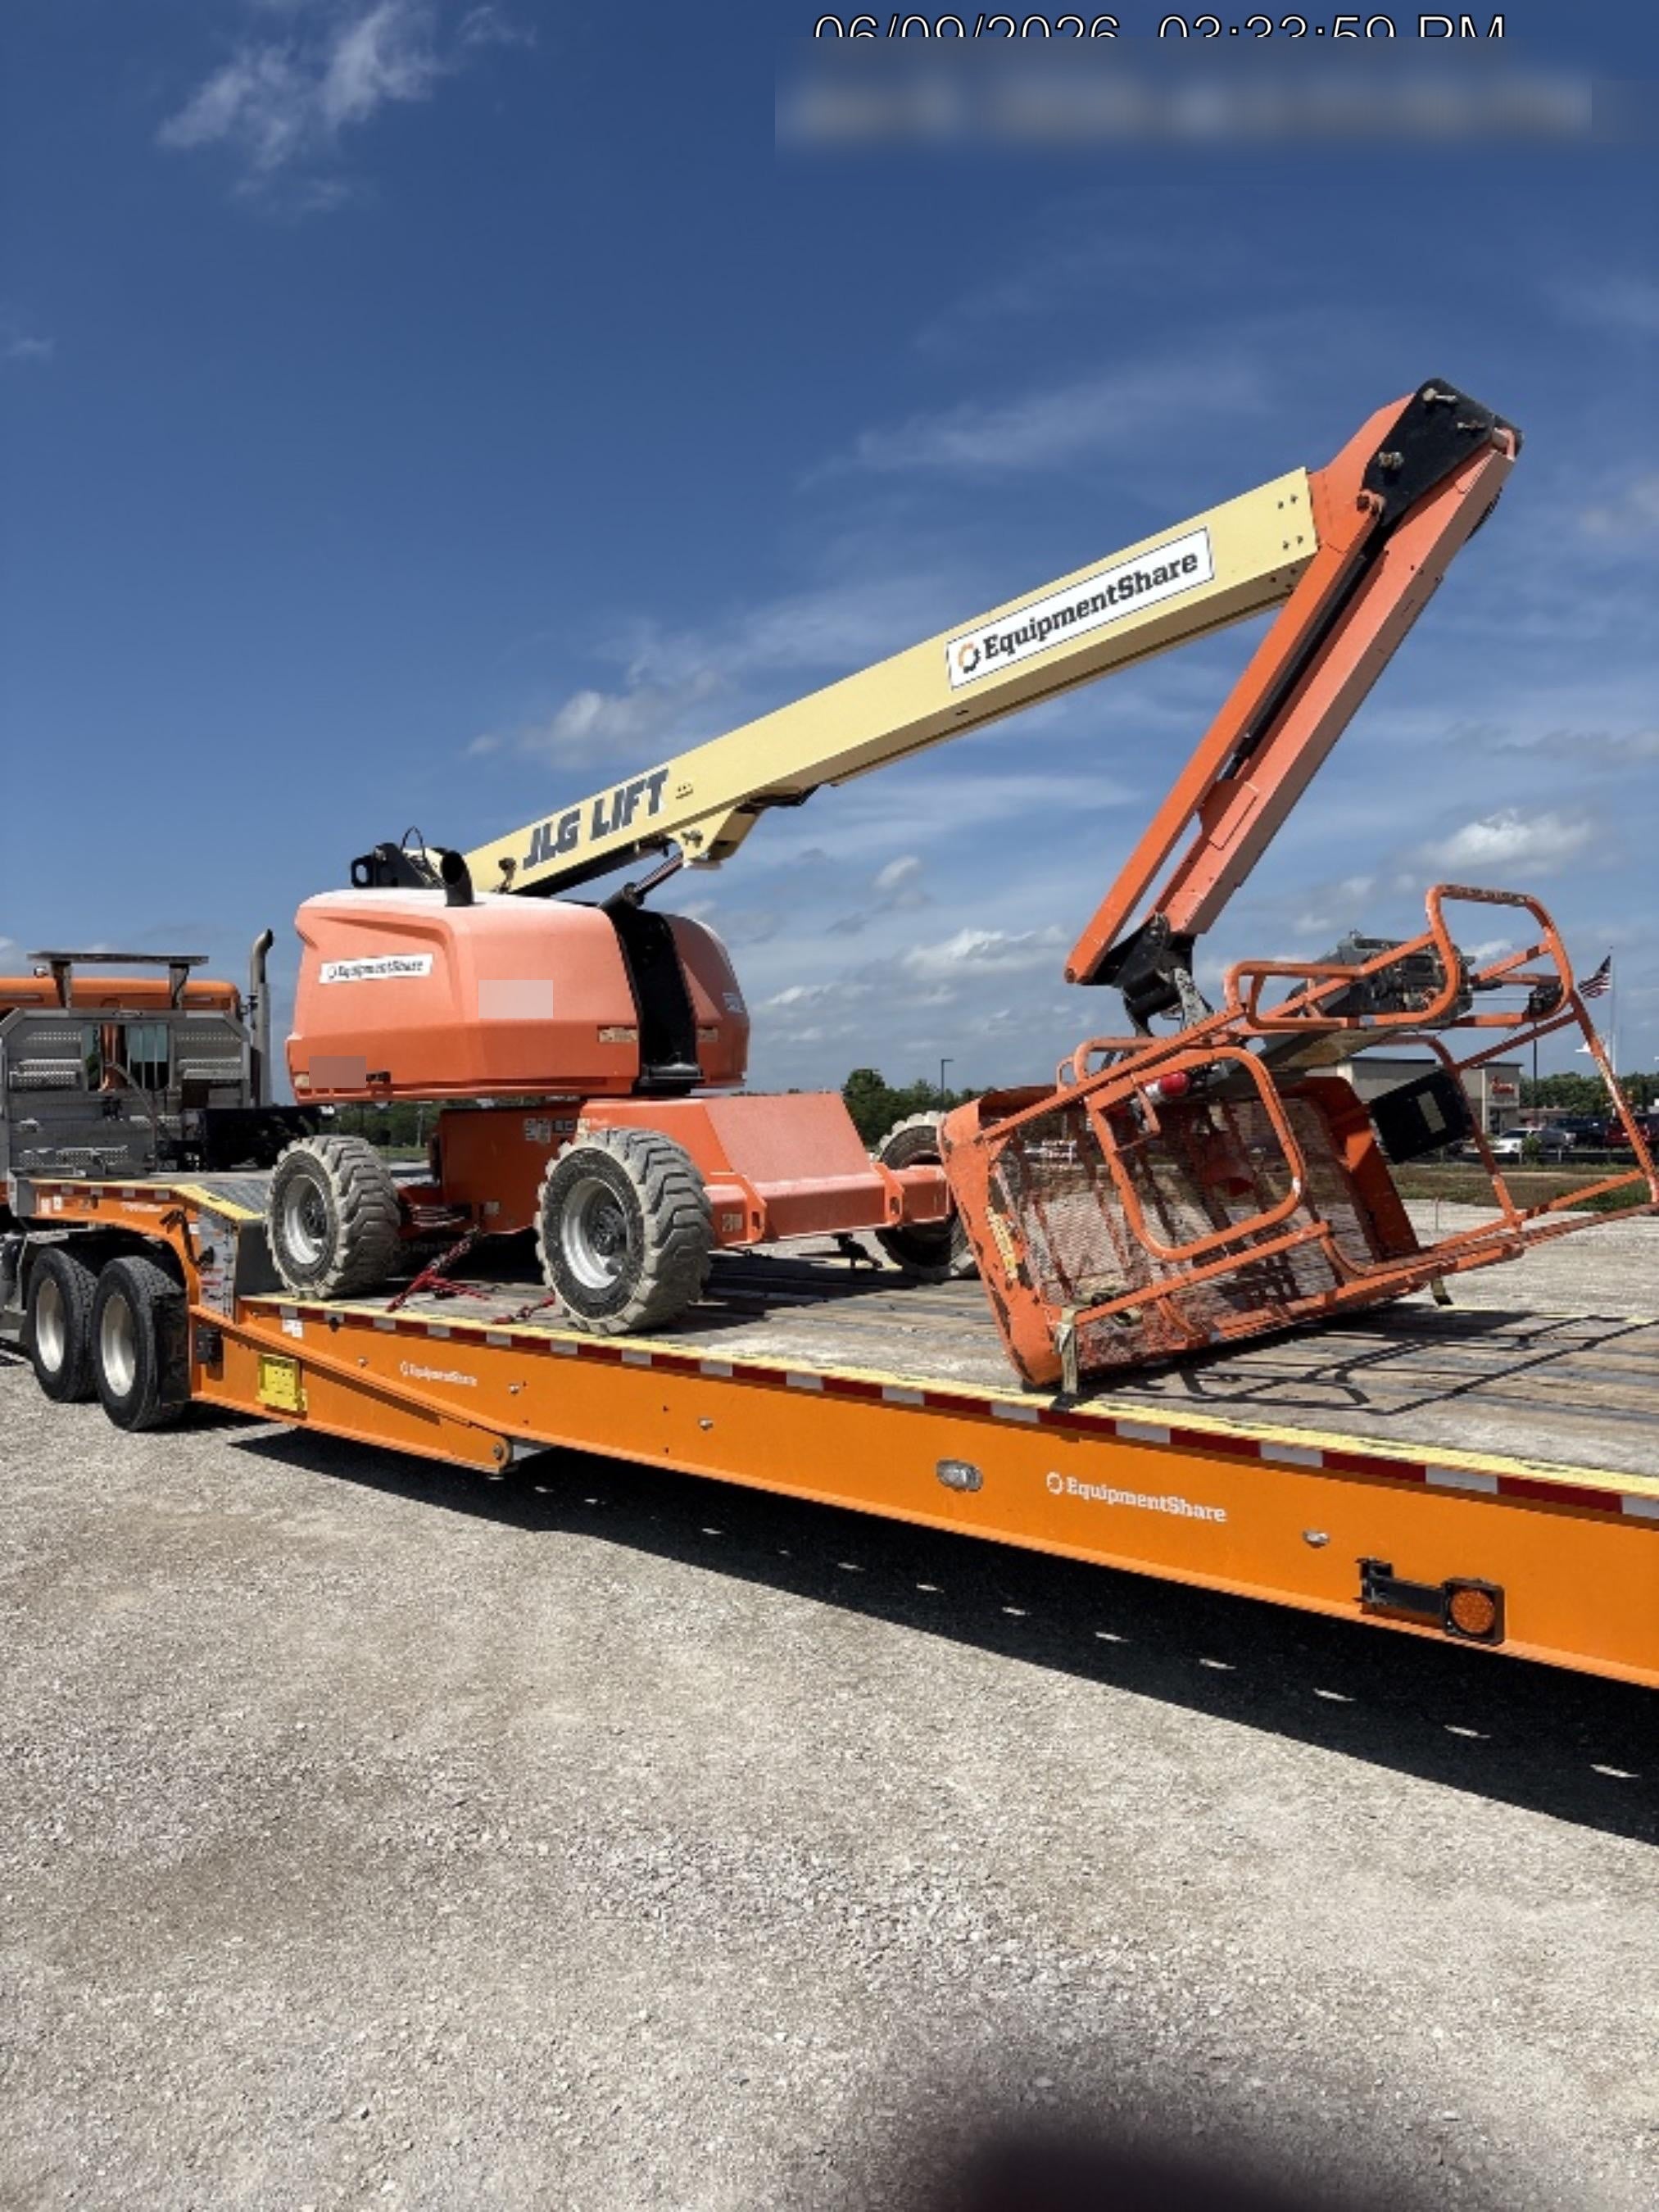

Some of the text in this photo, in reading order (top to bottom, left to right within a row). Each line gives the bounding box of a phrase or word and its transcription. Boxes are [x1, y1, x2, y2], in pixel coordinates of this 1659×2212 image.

[982, 552, 1199, 660] EquipmentShare
[524, 768, 669, 870] JLG LIFT
[1066, 1476, 1227, 1522] EquipmentShare
